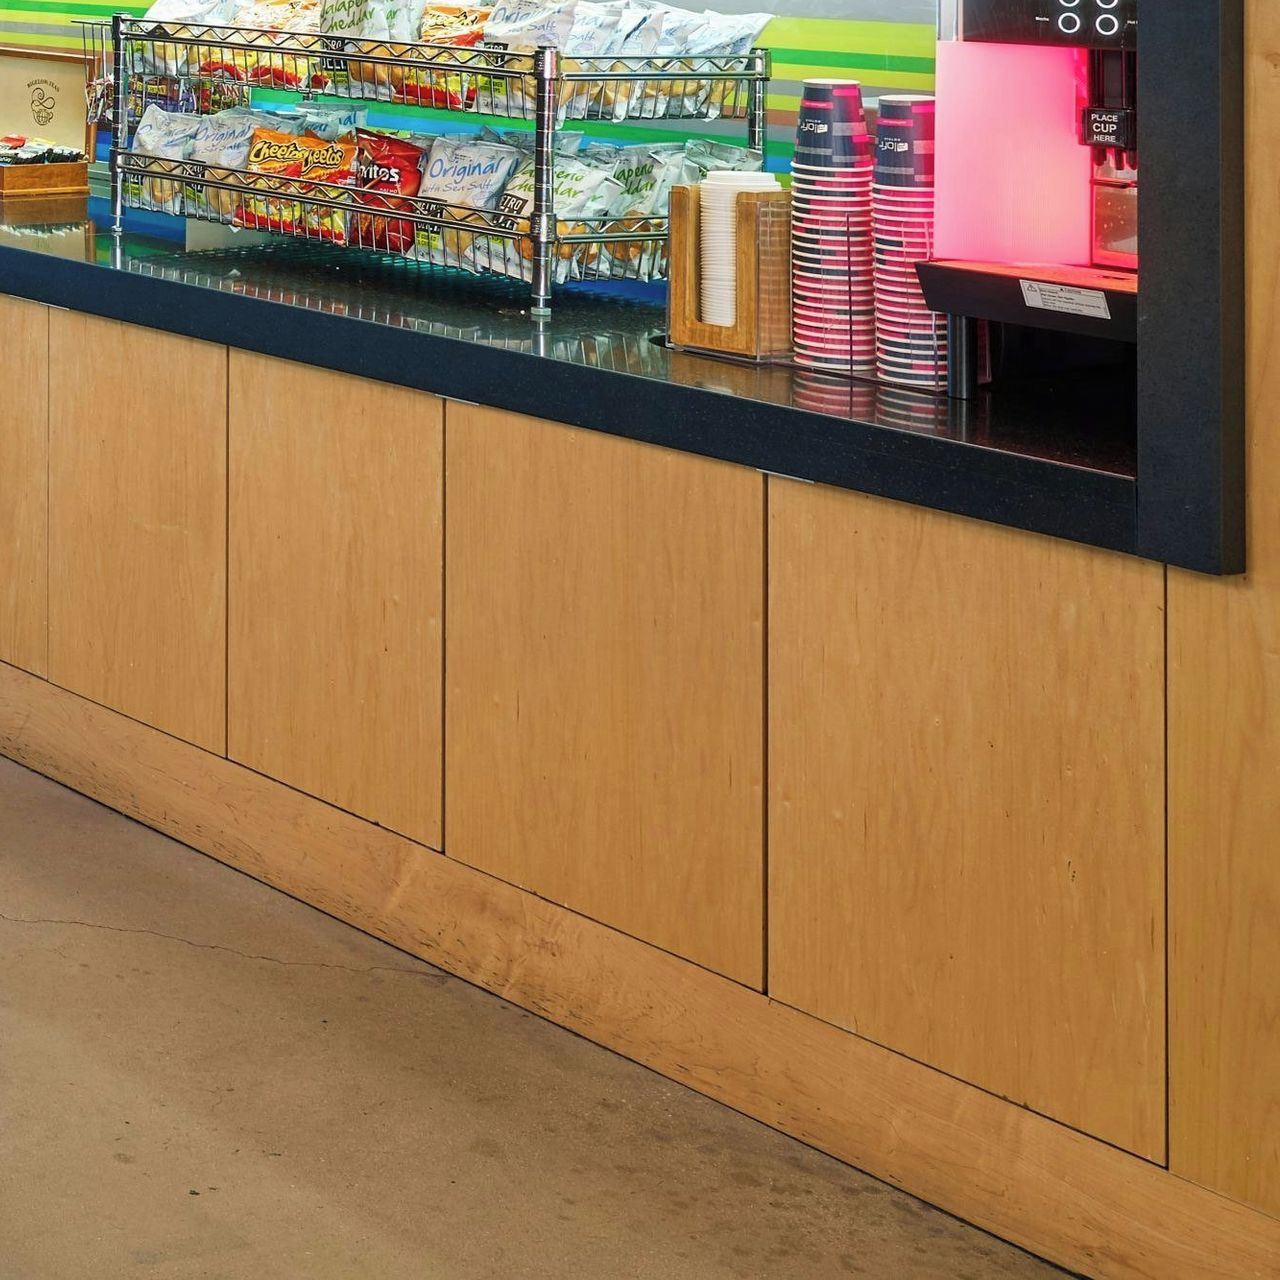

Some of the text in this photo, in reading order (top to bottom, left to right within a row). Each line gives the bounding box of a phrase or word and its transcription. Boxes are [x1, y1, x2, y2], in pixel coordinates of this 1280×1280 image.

[1091, 113, 1118, 123] PLACE
[1092, 122, 1117, 133] CUP
[1093, 134, 1116, 143] HERE
[429, 156, 505, 185] Original
